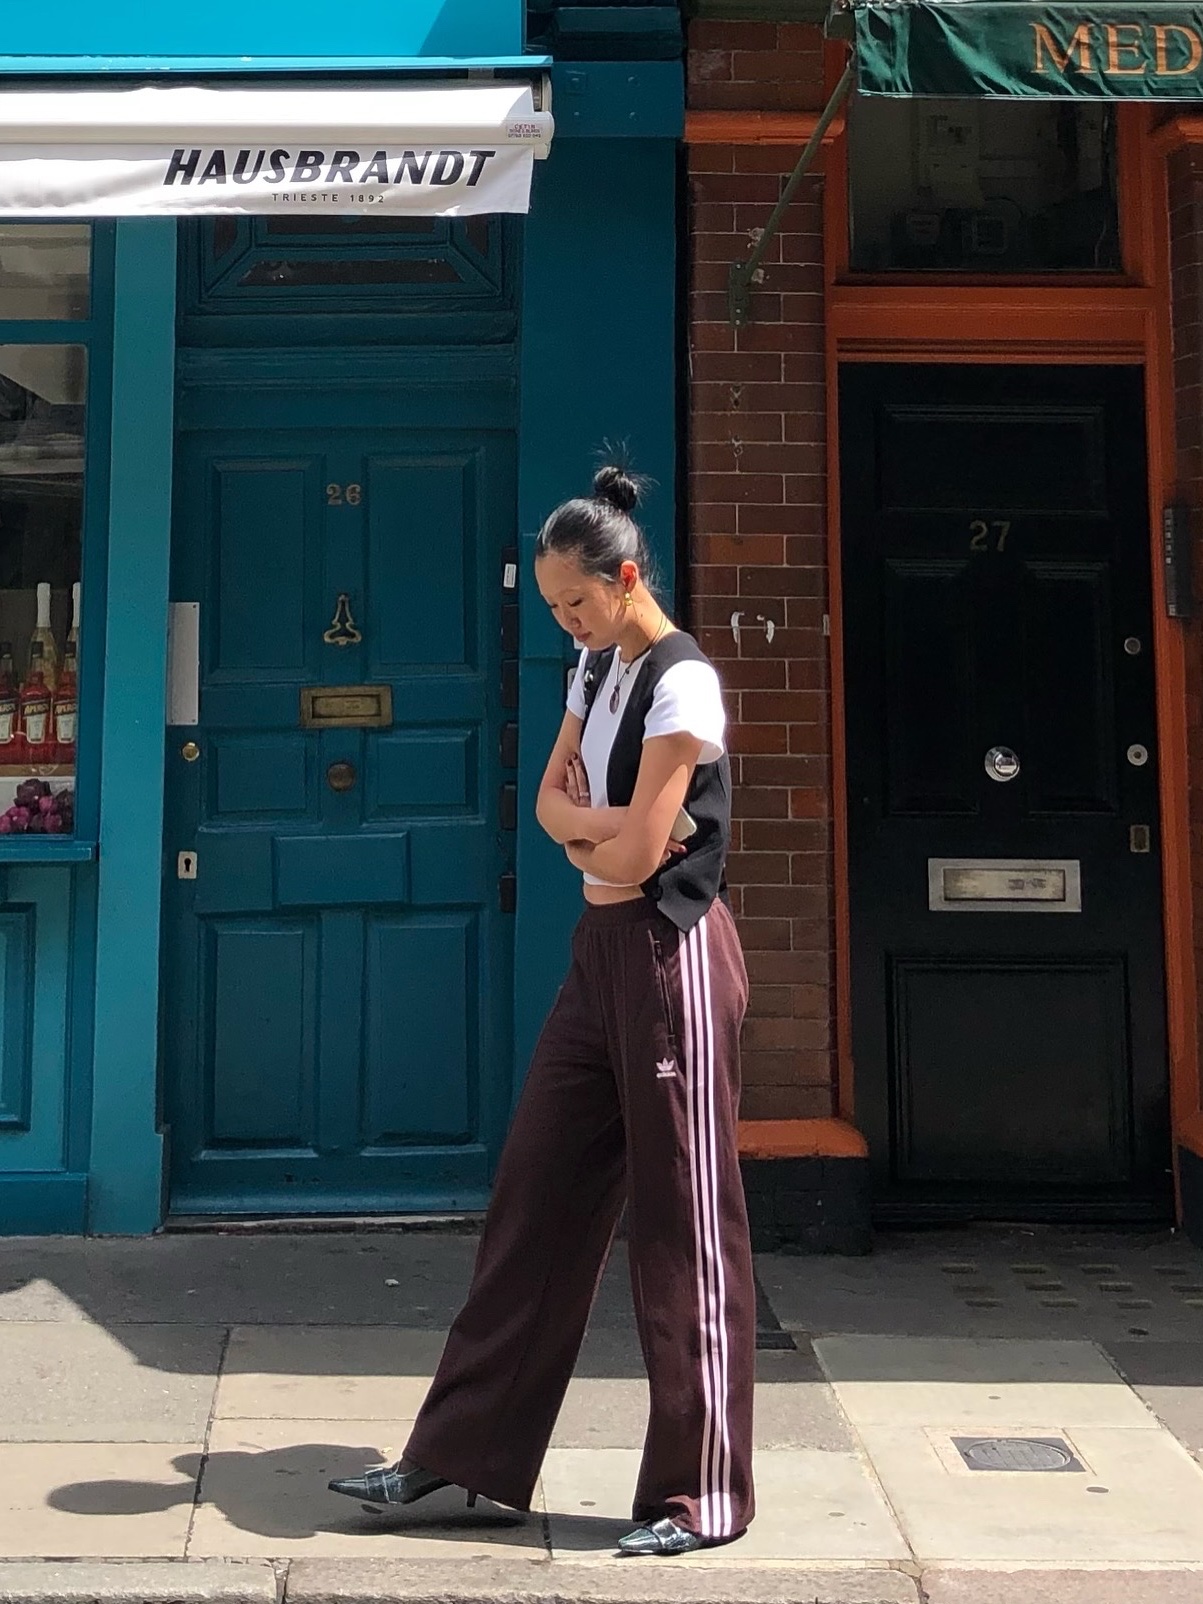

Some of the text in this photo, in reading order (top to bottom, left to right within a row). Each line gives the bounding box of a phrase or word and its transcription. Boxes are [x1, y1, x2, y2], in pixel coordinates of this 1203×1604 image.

[1029, 22, 1203, 76] MED
[163, 149, 496, 187] HAUSBRANDT
[272, 193, 384, 203] TRIESTE 1892
[326, 484, 361, 505] 26
[969, 520, 1011, 552] 27
